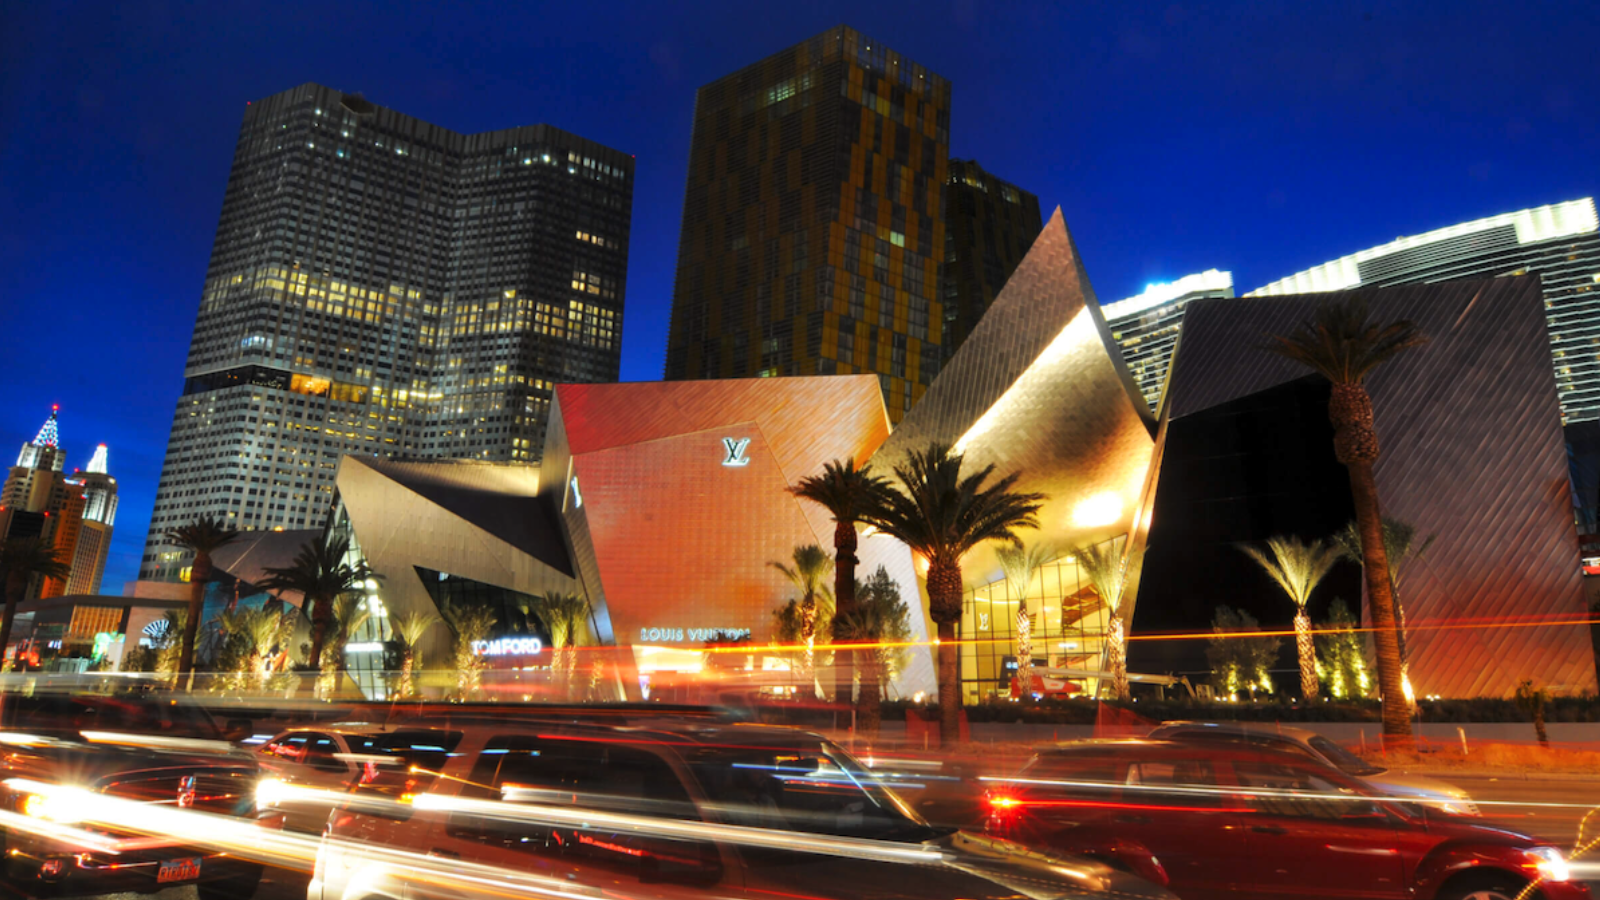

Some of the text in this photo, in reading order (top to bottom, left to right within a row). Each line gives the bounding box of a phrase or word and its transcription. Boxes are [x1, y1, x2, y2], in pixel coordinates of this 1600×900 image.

[641, 627, 684, 641] LOUIS
[471, 637, 542, 656] TOM FORD
